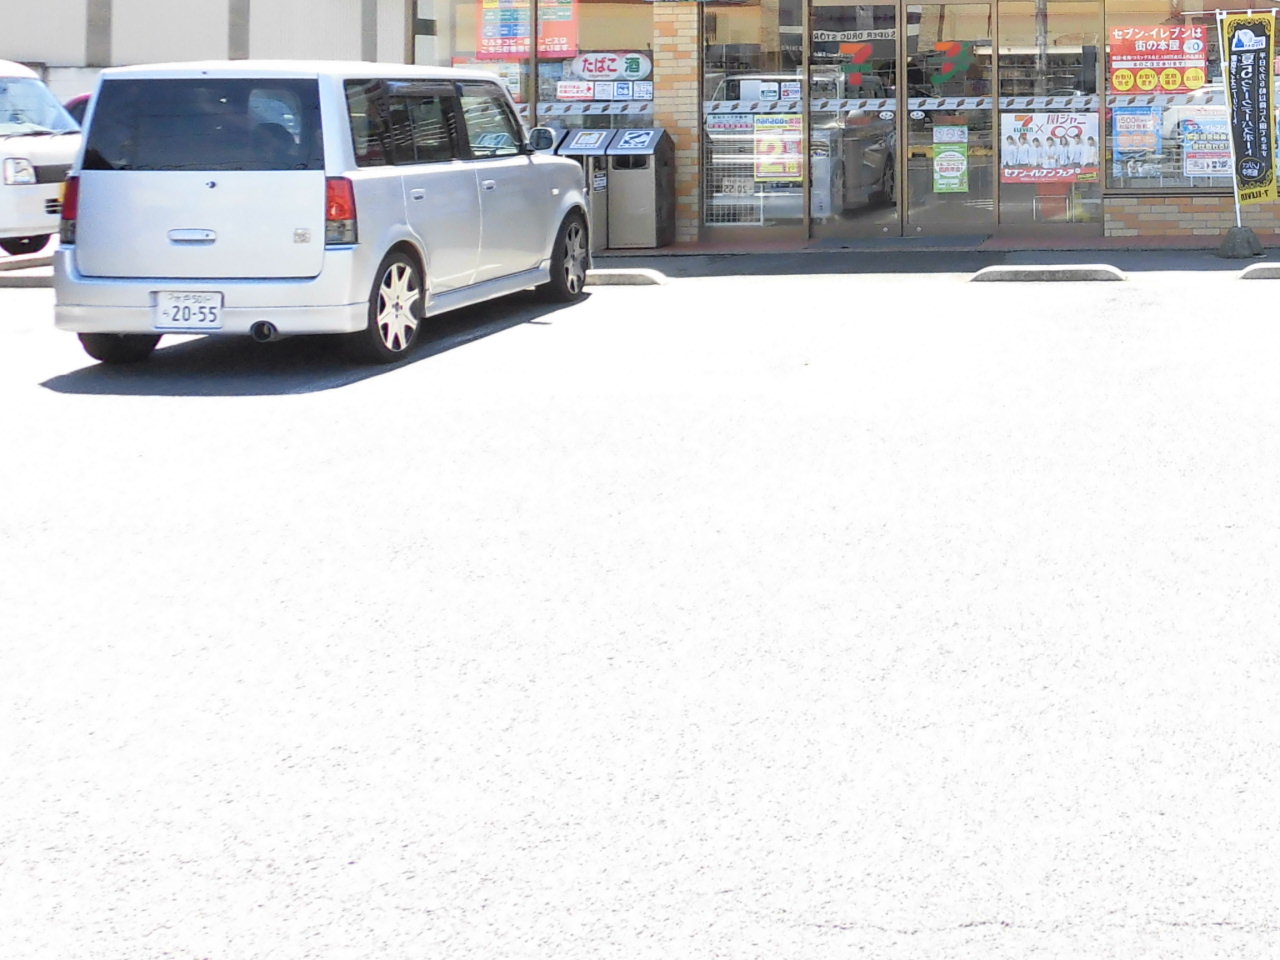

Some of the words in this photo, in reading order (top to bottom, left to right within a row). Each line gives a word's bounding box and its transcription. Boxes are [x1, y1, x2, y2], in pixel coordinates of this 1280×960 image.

[1135, 39, 1180, 52] 街の本屋
[582, 57, 619, 74] たばこ
[624, 56, 642, 74] 酒
[171, 305, 218, 323] 20-55
